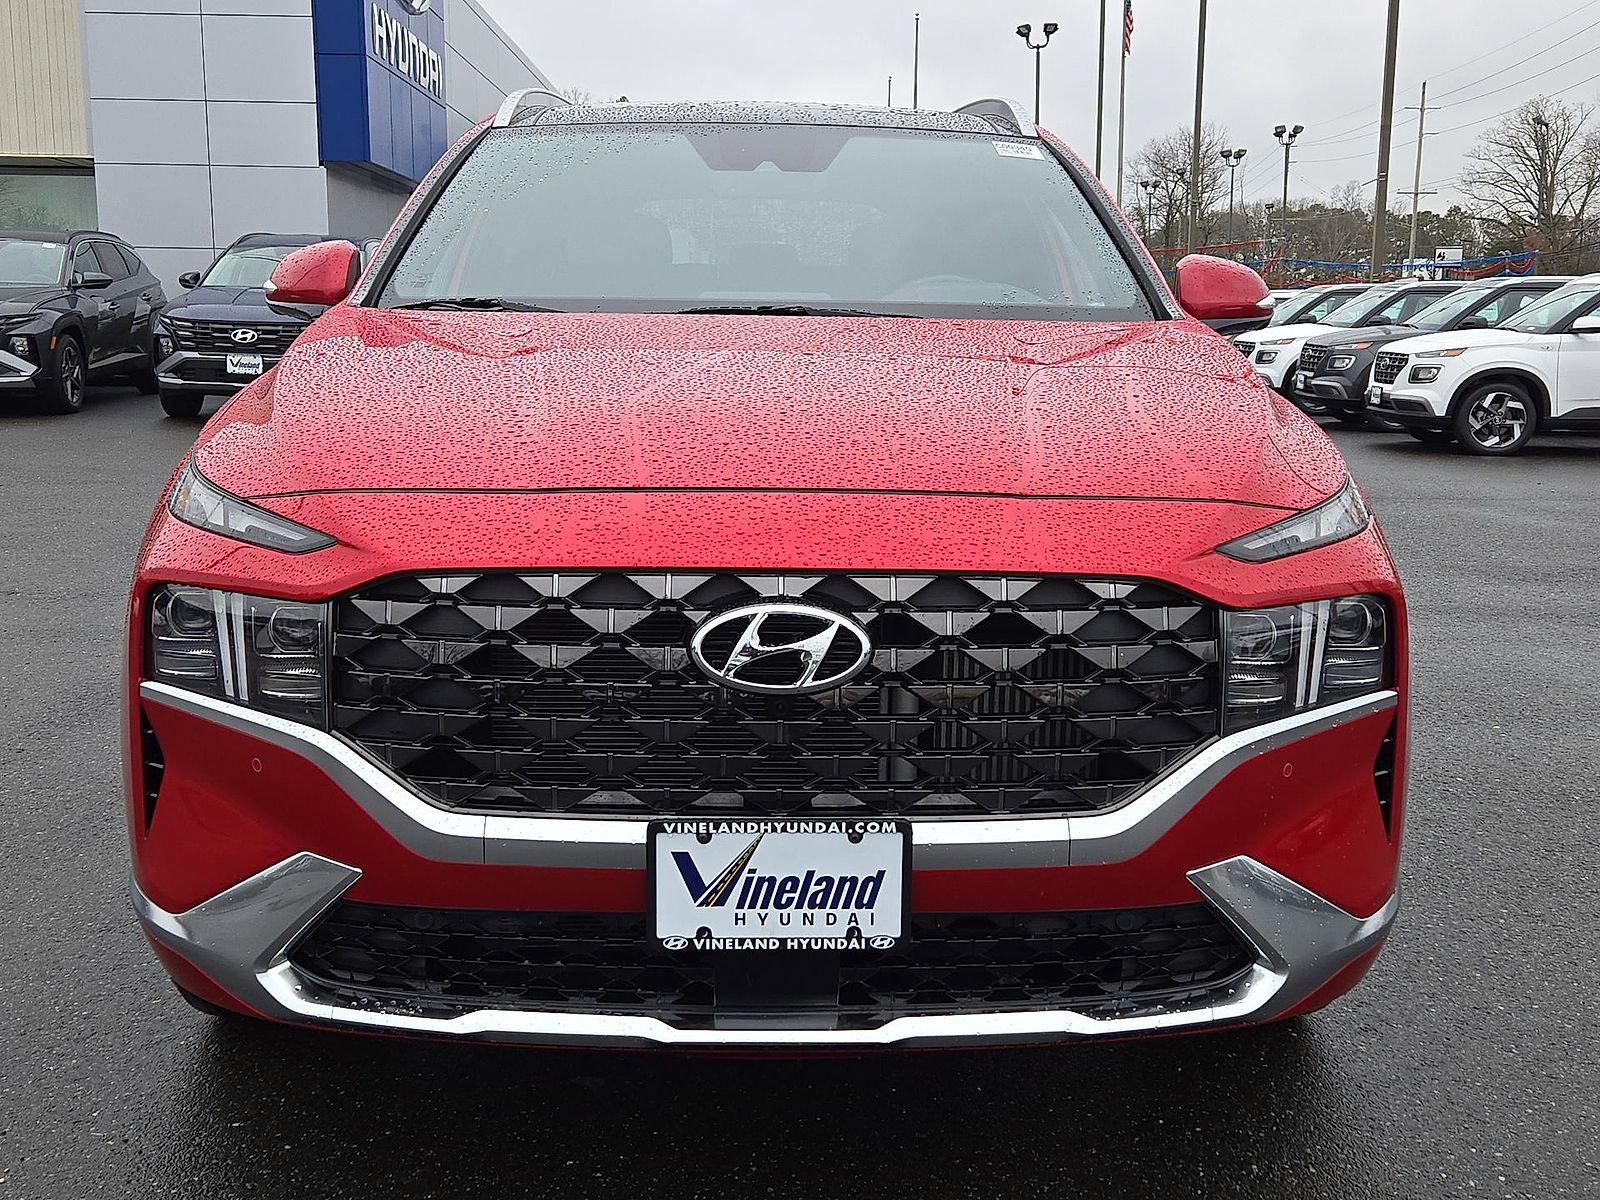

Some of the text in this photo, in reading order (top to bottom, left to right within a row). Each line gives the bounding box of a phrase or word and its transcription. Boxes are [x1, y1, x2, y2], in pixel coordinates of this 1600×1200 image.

[371, 2, 443, 99] HYUNDAI
[663, 821, 897, 834] VINELANDHYUNDAI.COM
[670, 833, 887, 910] Vineland
[734, 912, 875, 926] HYUNDAI
[693, 937, 866, 950] VINELAND HYUNDAI
